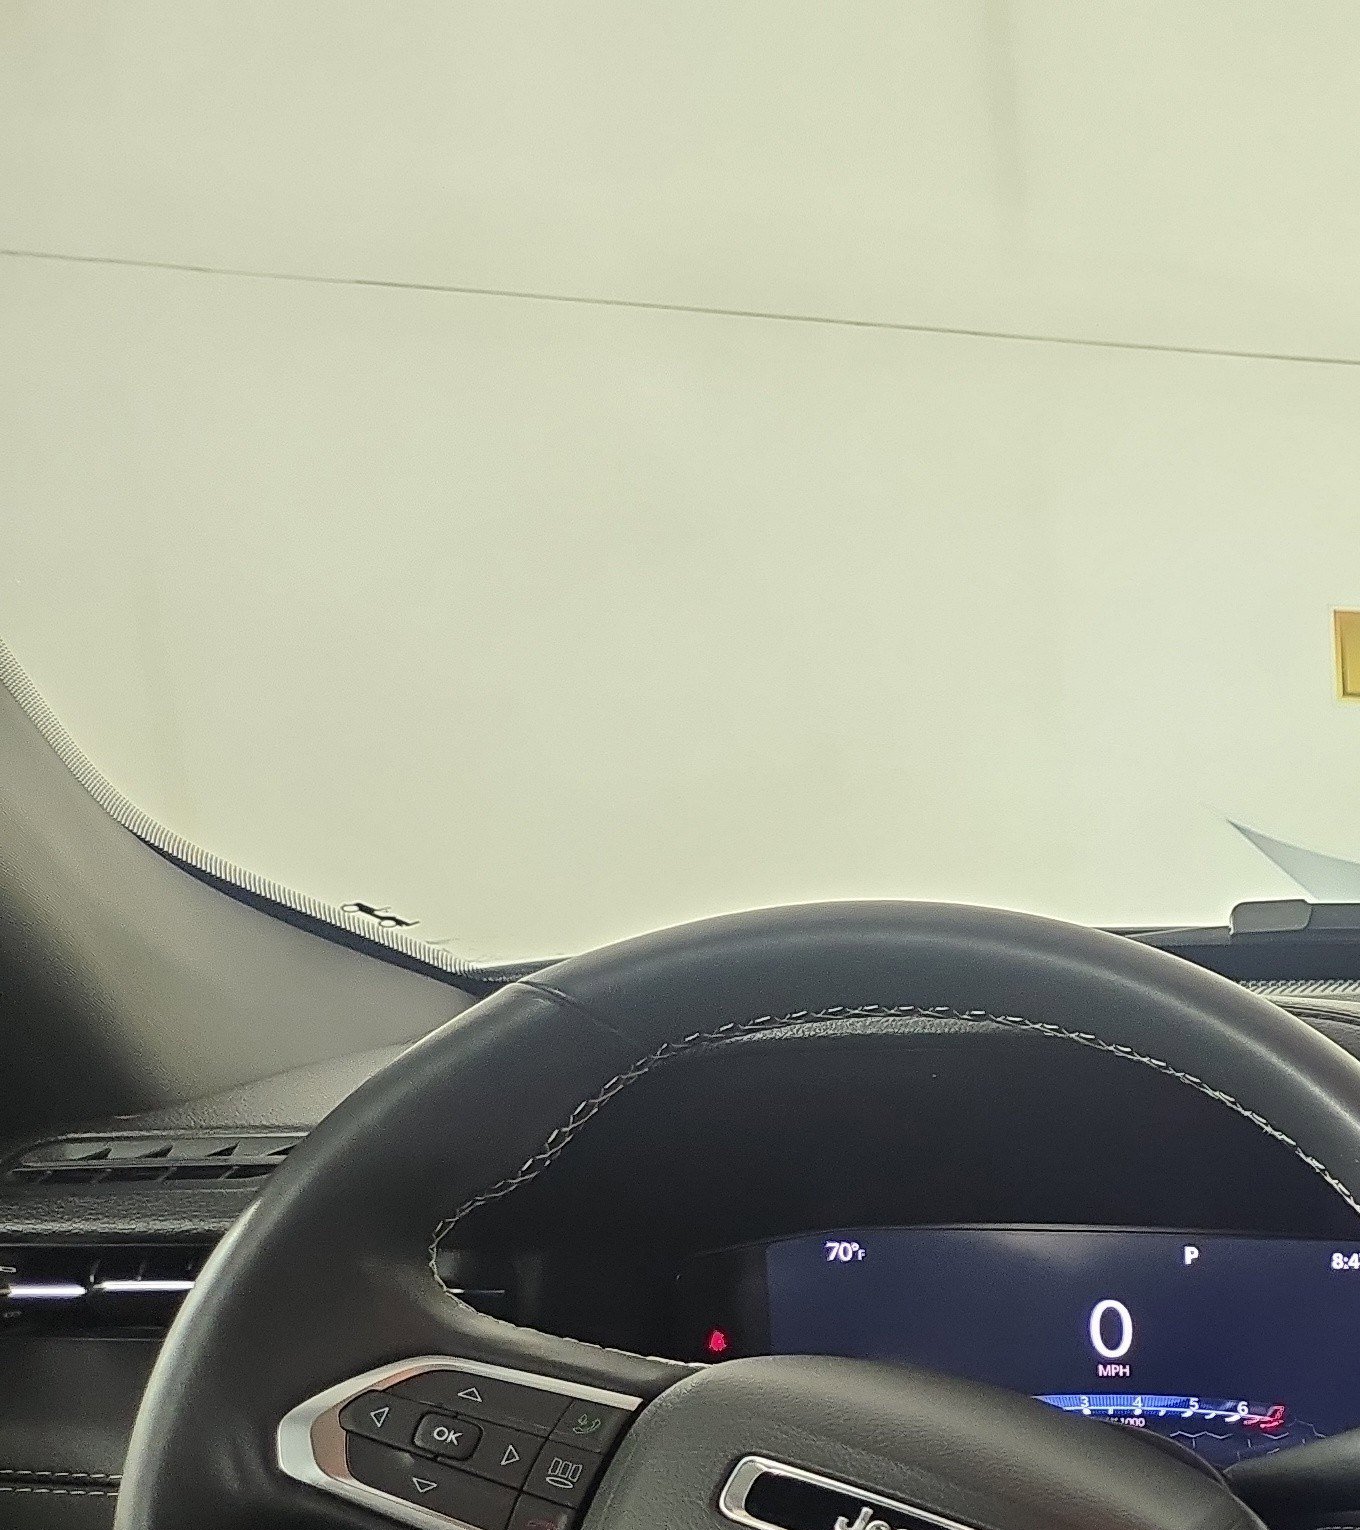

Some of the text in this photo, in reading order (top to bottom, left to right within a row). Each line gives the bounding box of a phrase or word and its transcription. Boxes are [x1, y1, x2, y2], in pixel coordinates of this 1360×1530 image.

[1185, 1246, 1199, 1266] P
[1089, 1298, 1134, 1358] 0
[1098, 1364, 1131, 1378] MPH
[1080, 1396, 1089, 1407] 3
[1133, 1396, 1143, 1407] 4
[1189, 1397, 1199, 1410] 5
[1237, 1401, 1249, 1415] 6
[433, 1425, 463, 1446] OK
